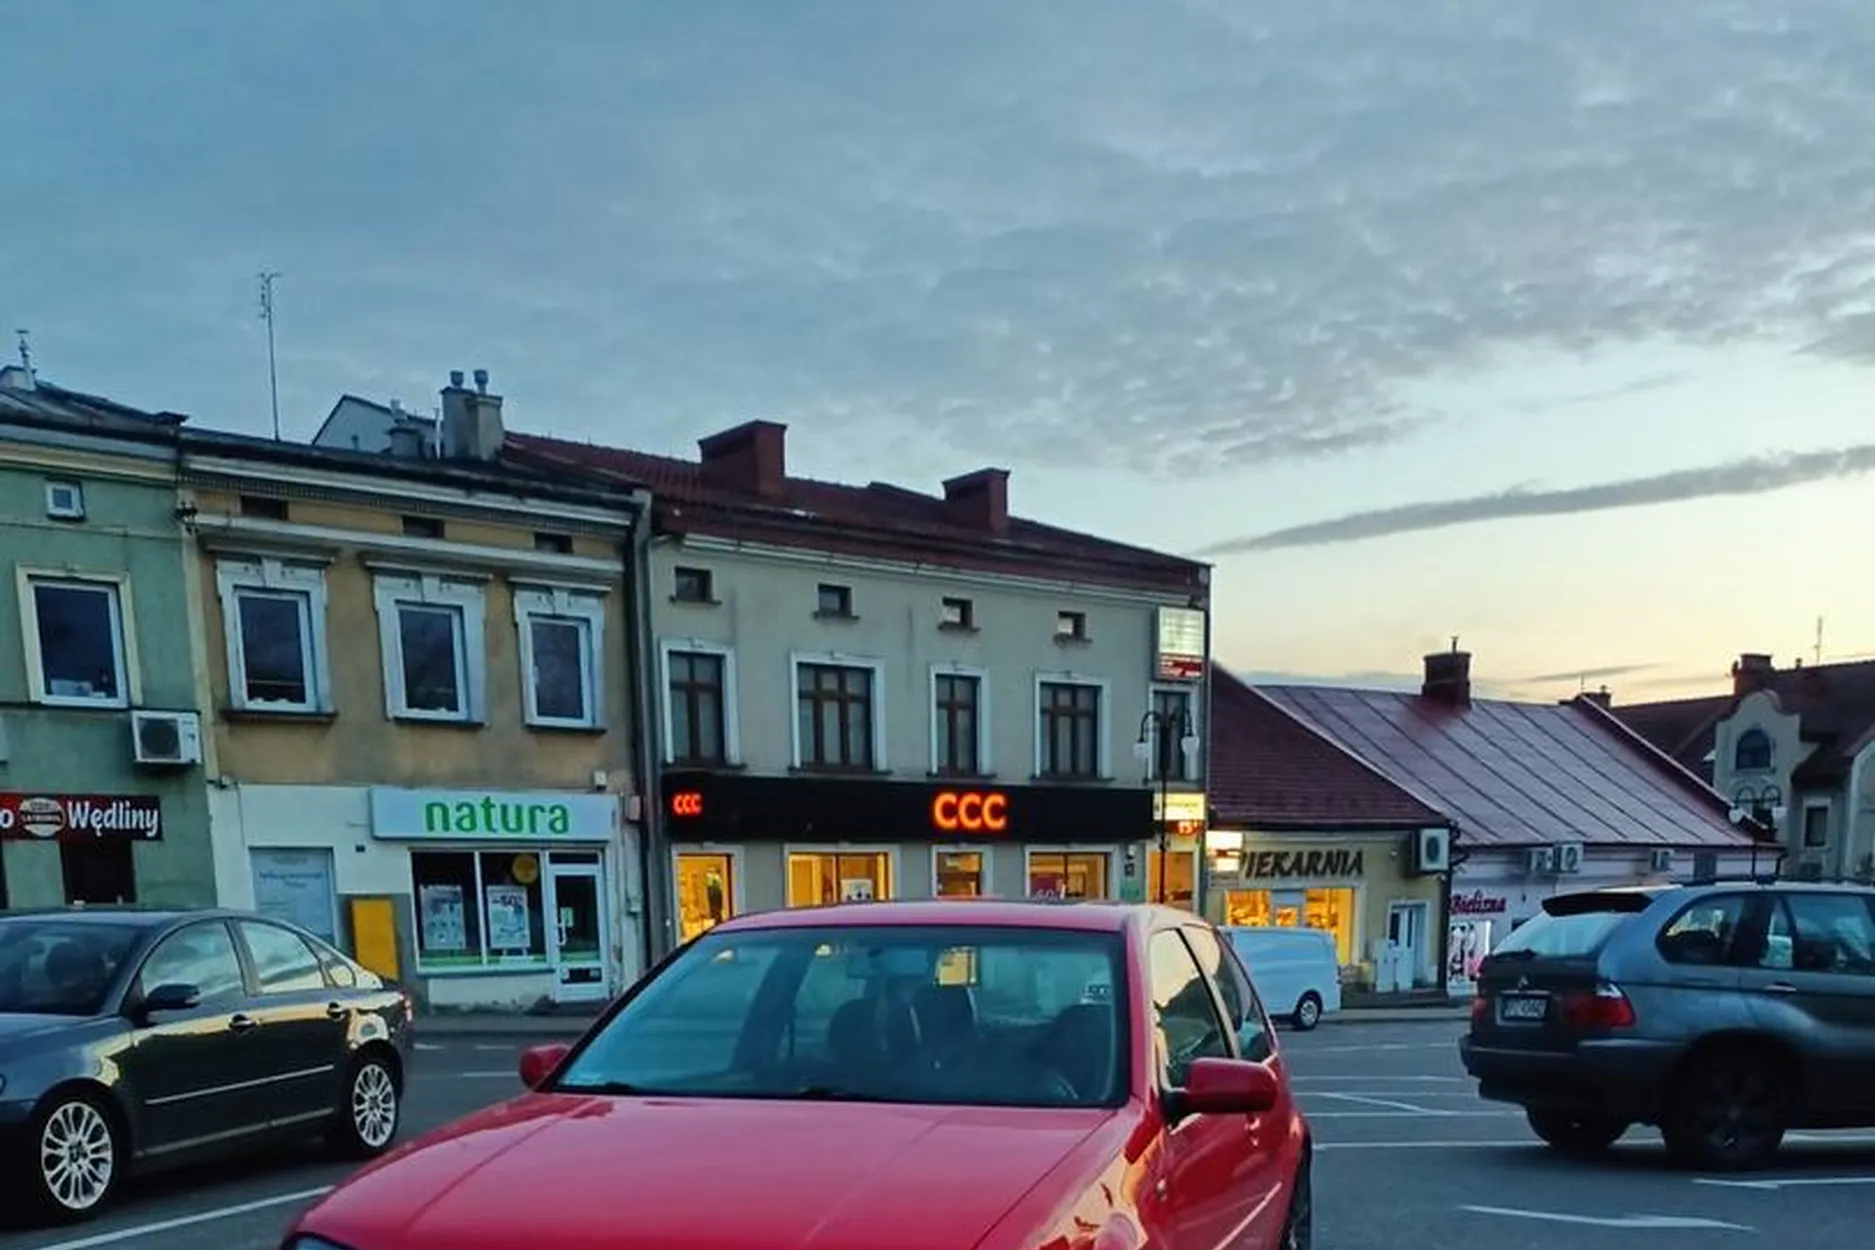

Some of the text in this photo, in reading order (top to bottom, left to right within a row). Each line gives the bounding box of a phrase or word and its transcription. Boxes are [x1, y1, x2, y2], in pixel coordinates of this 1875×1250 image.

[67, 801, 158, 837] Wędliny
[426, 797, 570, 834] natura
[673, 794, 701, 815] CCC
[933, 793, 1006, 829] CCC
[1241, 849, 1363, 878] IEKARNIA
